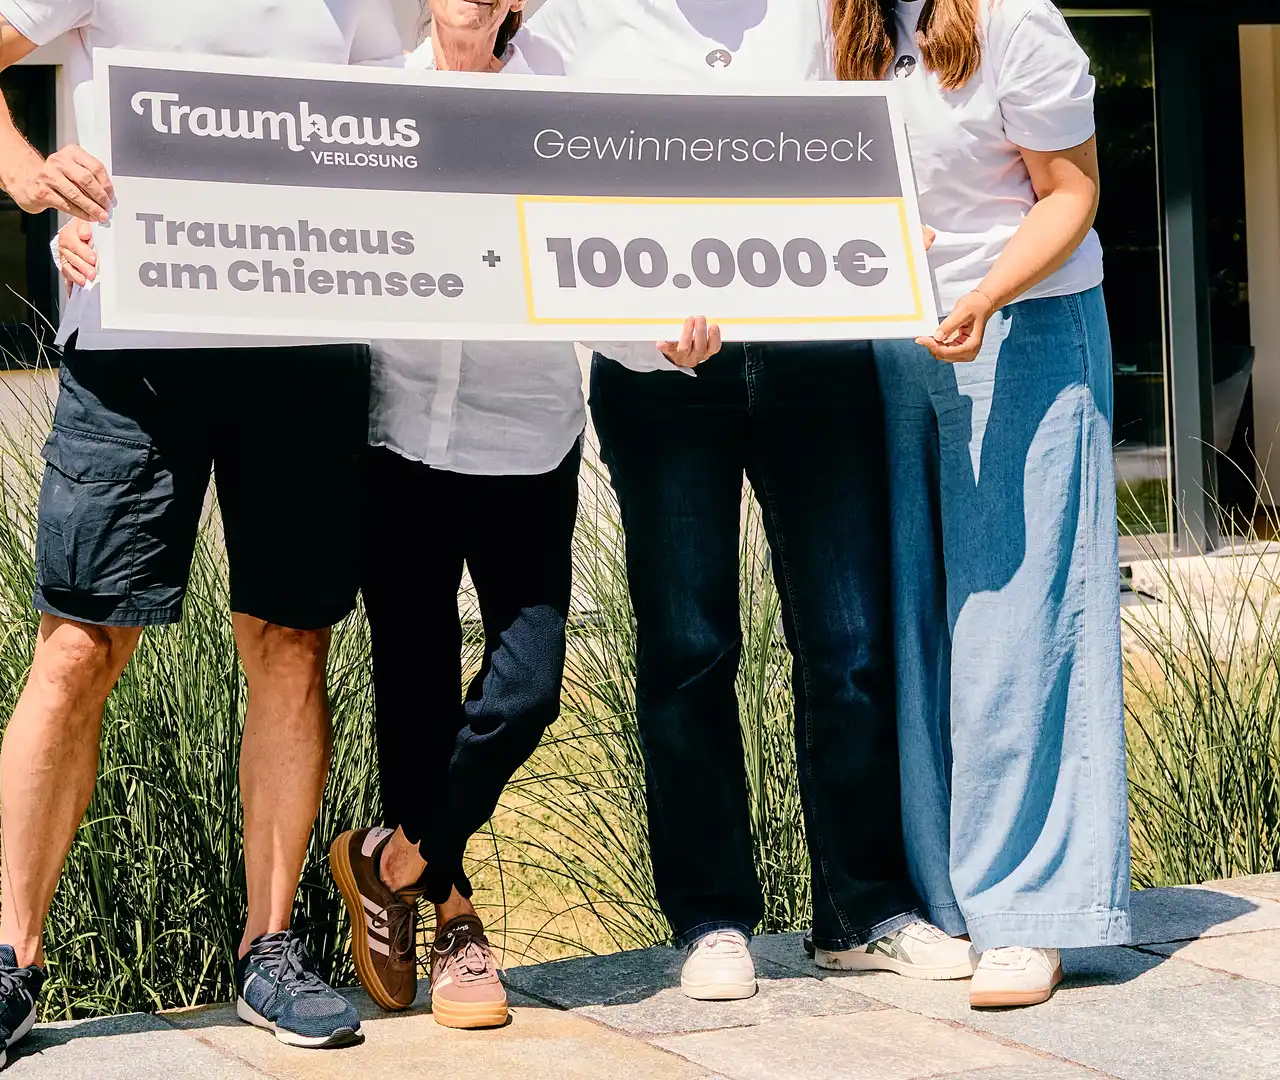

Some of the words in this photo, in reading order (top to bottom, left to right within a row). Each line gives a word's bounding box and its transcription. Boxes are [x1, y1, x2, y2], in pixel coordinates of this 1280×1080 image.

[131, 91, 420, 151] Traumhaus
[311, 150, 418, 168] VERLOSUNG
[534, 129, 874, 162] Gewinnerscheck
[136, 213, 414, 255] Traumhaus
[139, 261, 218, 290] am
[228, 258, 464, 297] Chiemsee
[482, 250, 501, 267] +
[546, 237, 888, 288] 100.000€
